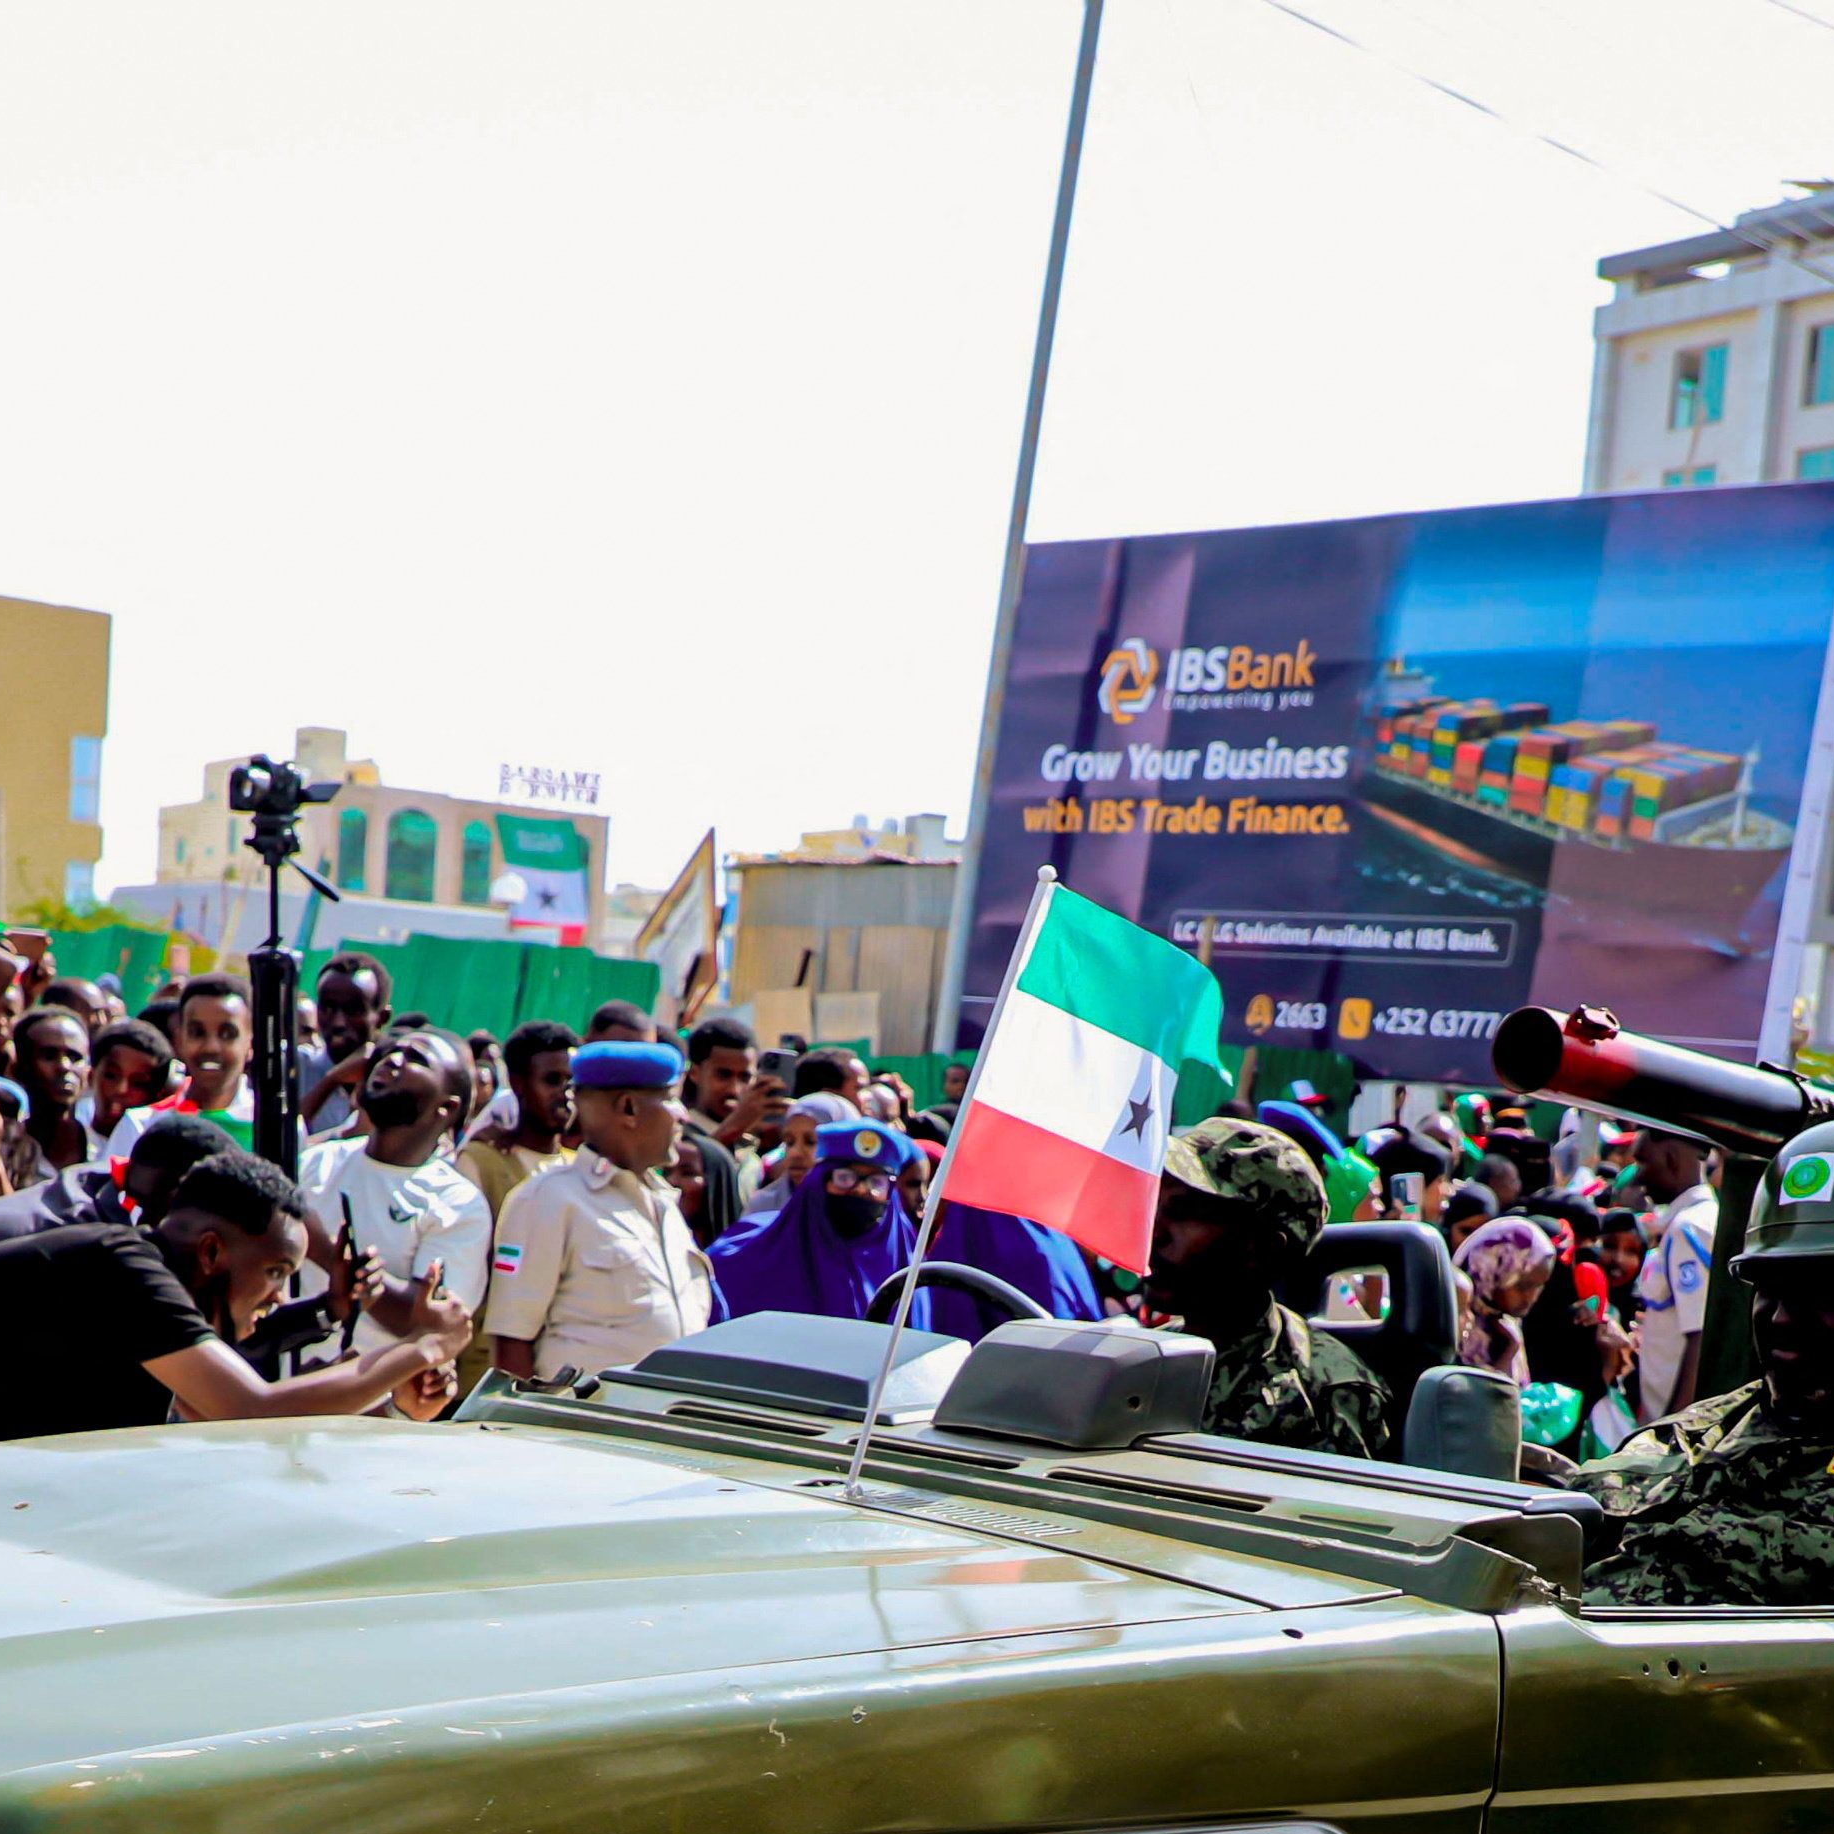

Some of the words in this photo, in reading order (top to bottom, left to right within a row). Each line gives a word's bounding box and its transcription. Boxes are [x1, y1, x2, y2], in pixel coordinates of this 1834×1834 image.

[1165, 638, 1318, 693] IBSBank
[1162, 690, 1274, 712] Empowering
[1278, 690, 1315, 711] you
[1040, 743, 1122, 783] Grow
[1127, 741, 1202, 781] Your
[1203, 736, 1351, 781] Business
[1023, 795, 1084, 834] with
[1088, 798, 1136, 834] IBS
[1141, 796, 1222, 835] Trade
[1226, 796, 1352, 835] Finance.
[1234, 921, 1312, 946] Solutions
[1312, 924, 1393, 949] Available
[1393, 927, 1414, 950] at
[1415, 928, 1447, 951] IBS
[1448, 927, 1500, 953] Bank.
[1274, 1001, 1328, 1029] 2663
[1372, 1006, 1428, 1036] +252
